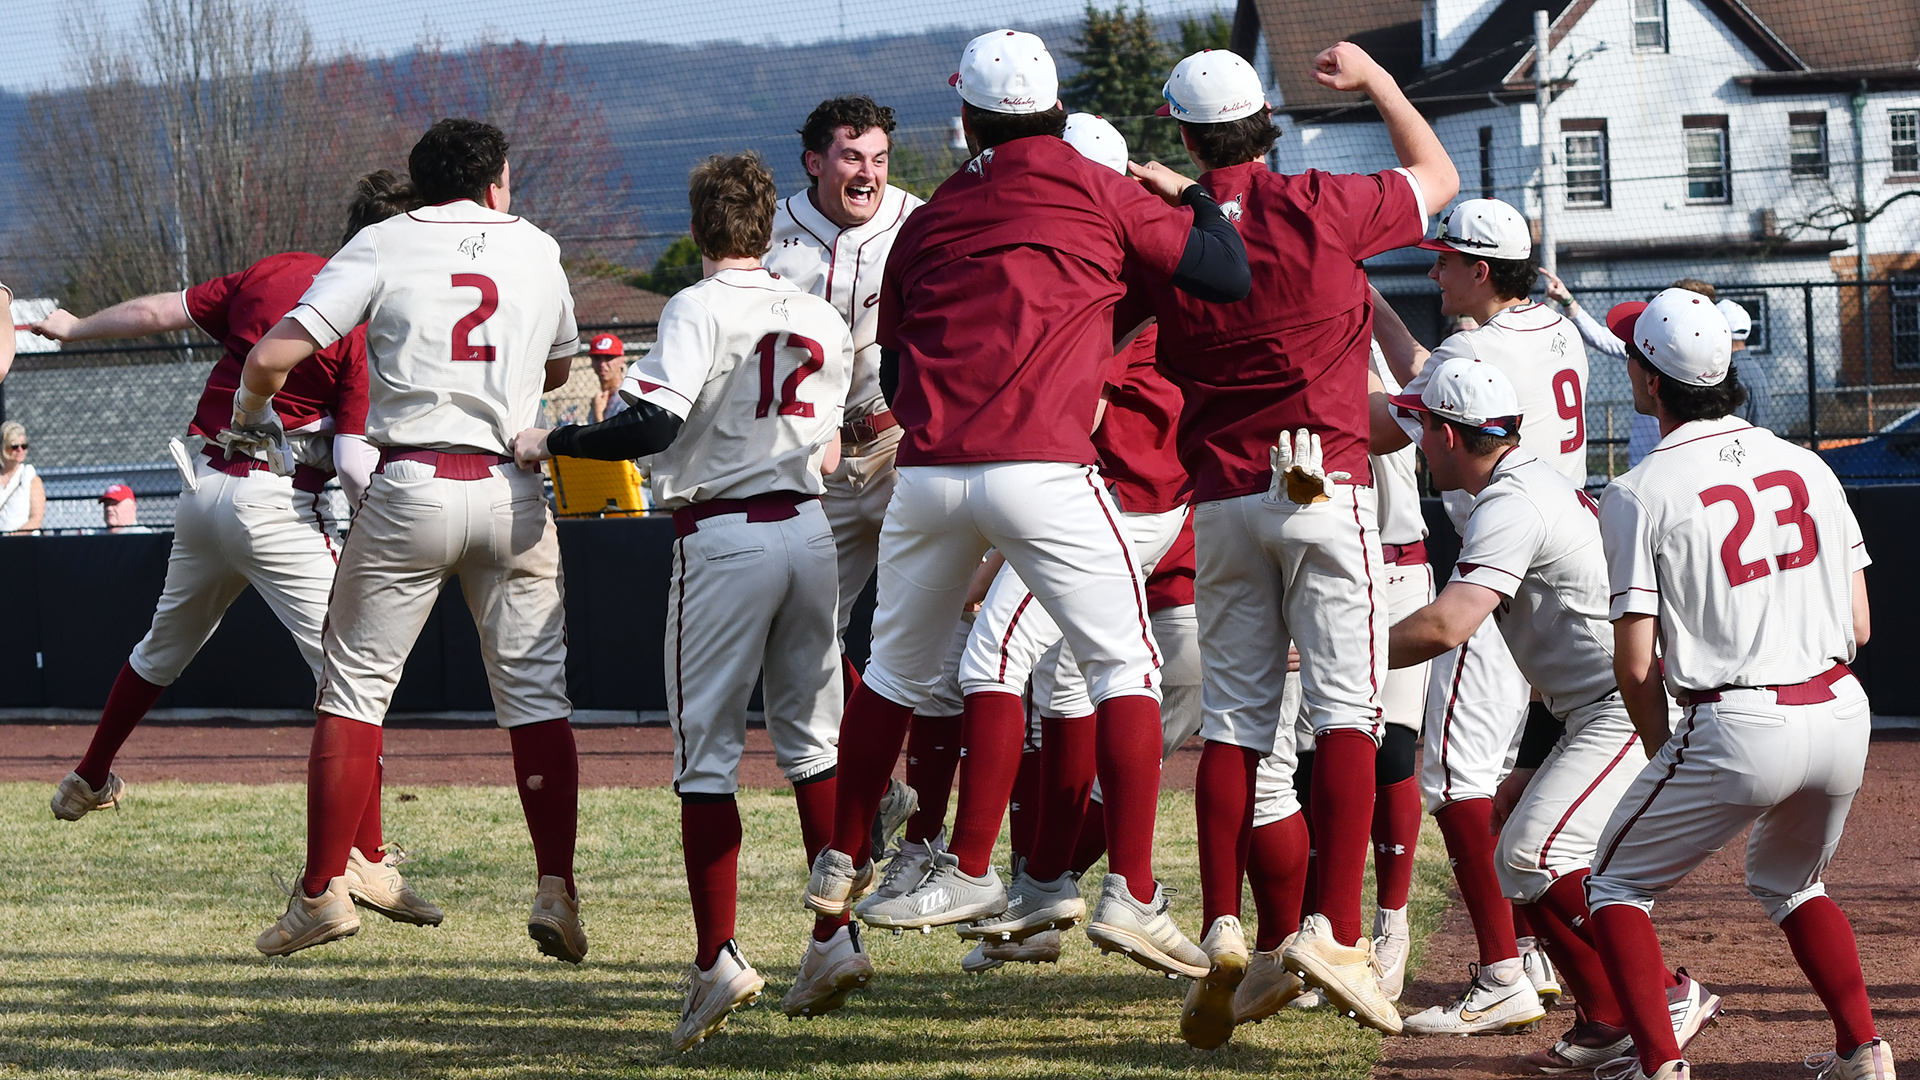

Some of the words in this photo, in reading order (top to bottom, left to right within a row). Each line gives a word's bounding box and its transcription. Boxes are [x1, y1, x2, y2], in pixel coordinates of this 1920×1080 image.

[450, 272, 499, 362] 2
[754, 331, 825, 419] 12
[1552, 368, 1585, 454] 9
[1697, 469, 1819, 588] 23
